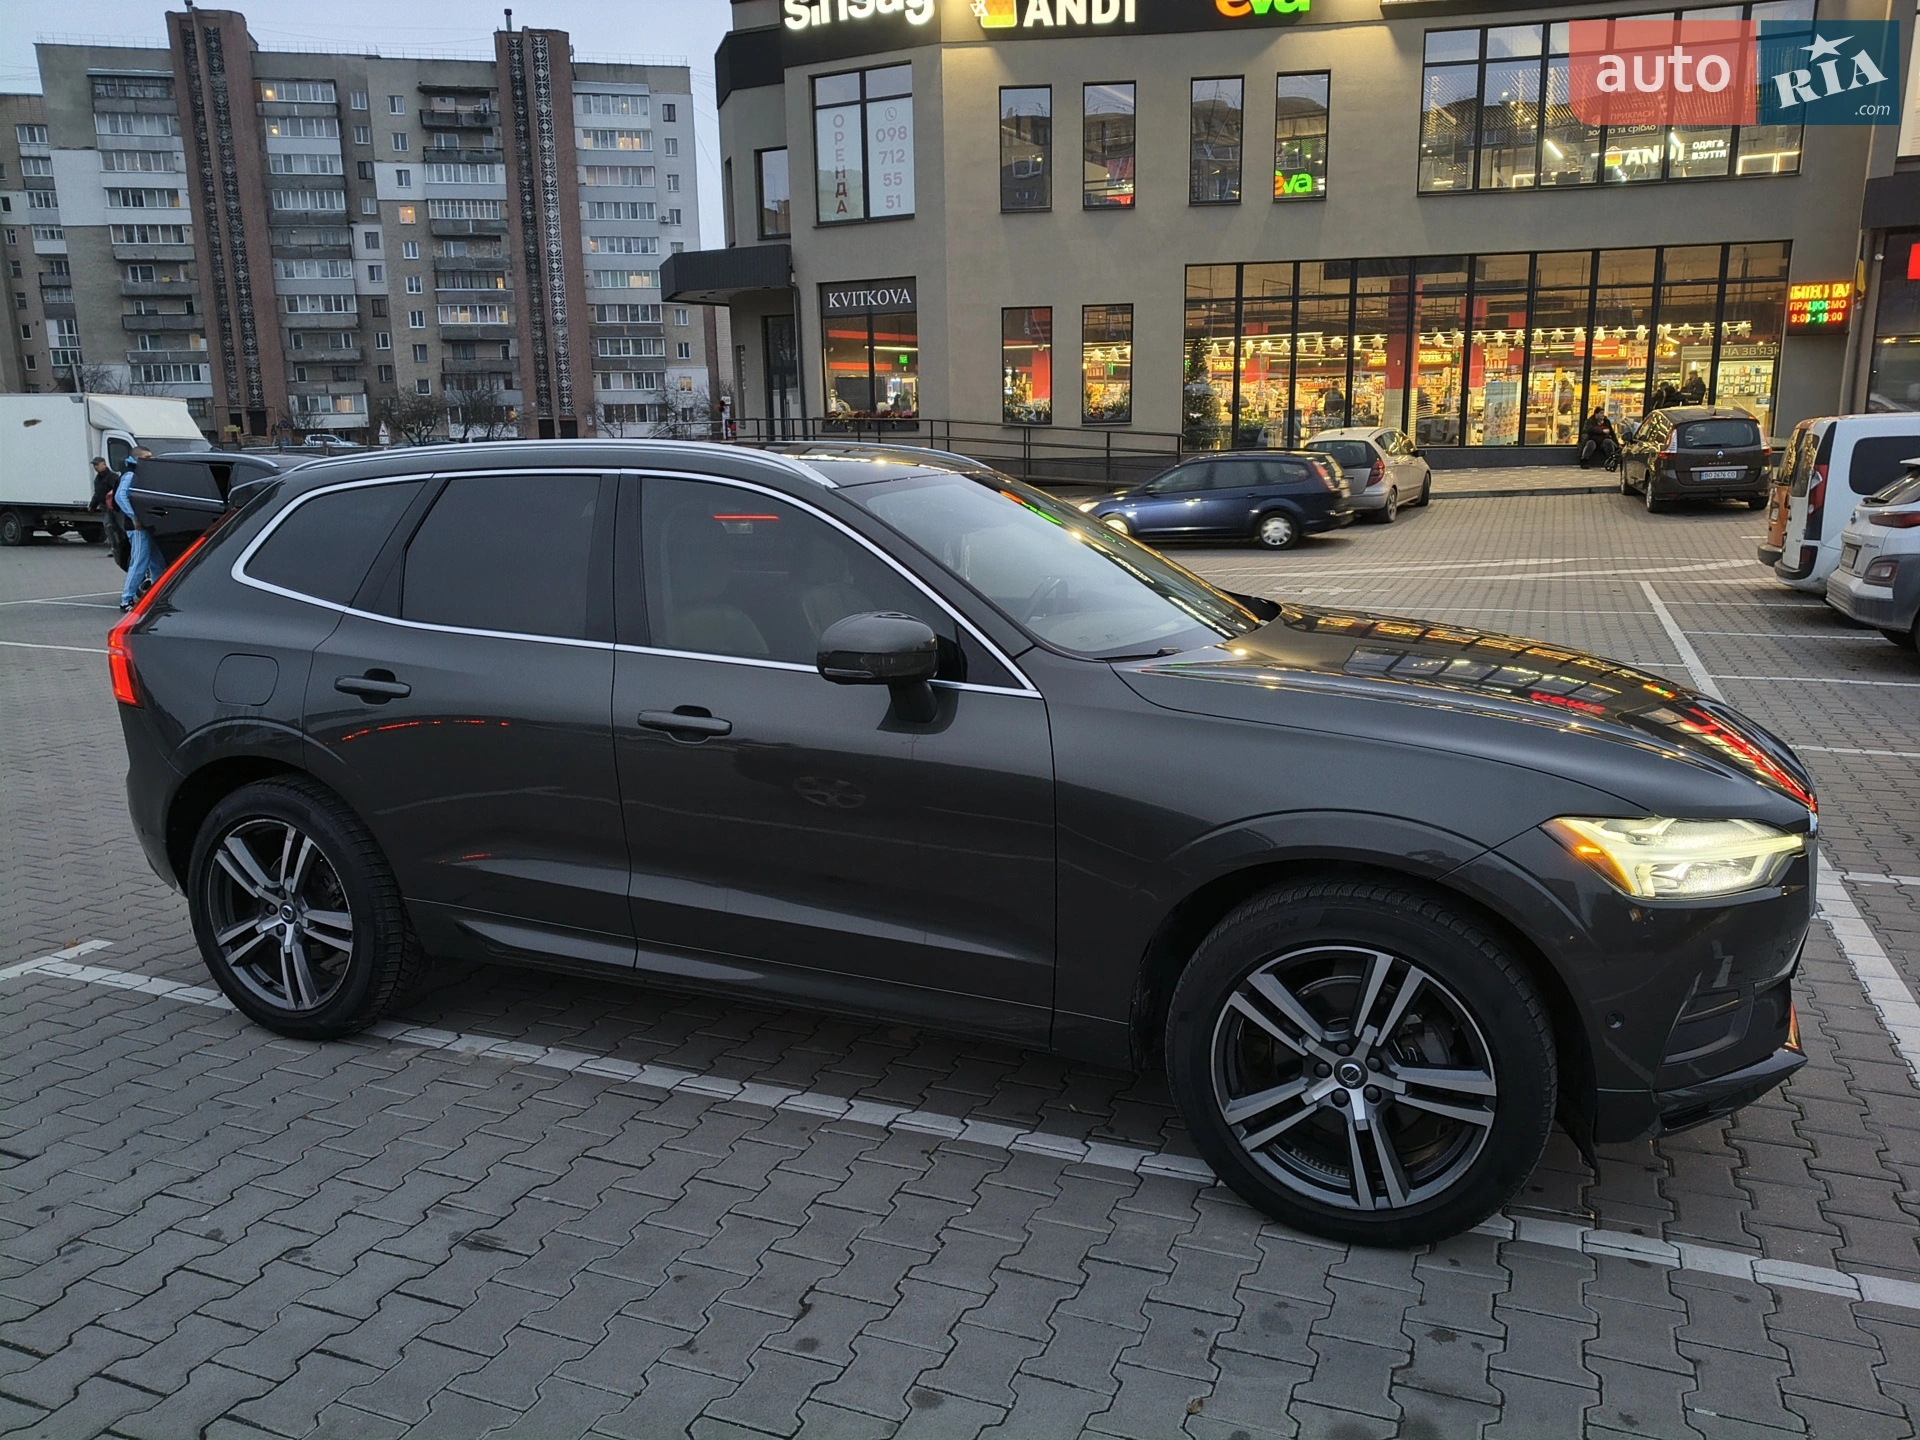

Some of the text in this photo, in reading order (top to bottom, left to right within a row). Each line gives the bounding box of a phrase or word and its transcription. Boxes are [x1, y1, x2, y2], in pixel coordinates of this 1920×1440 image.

[1022, 0, 1136, 27] ANDI
[876, 126, 907, 143] 098
[833, 114, 848, 214] ОРЕНДА
[879, 149, 905, 165] 712
[883, 172, 903, 187] 55
[885, 194, 902, 209] 51
[828, 288, 912, 308] KVITKOVA
[1789, 300, 1847, 312] ПРАЦЮЄМО
[1722, 347, 1740, 356] НА
